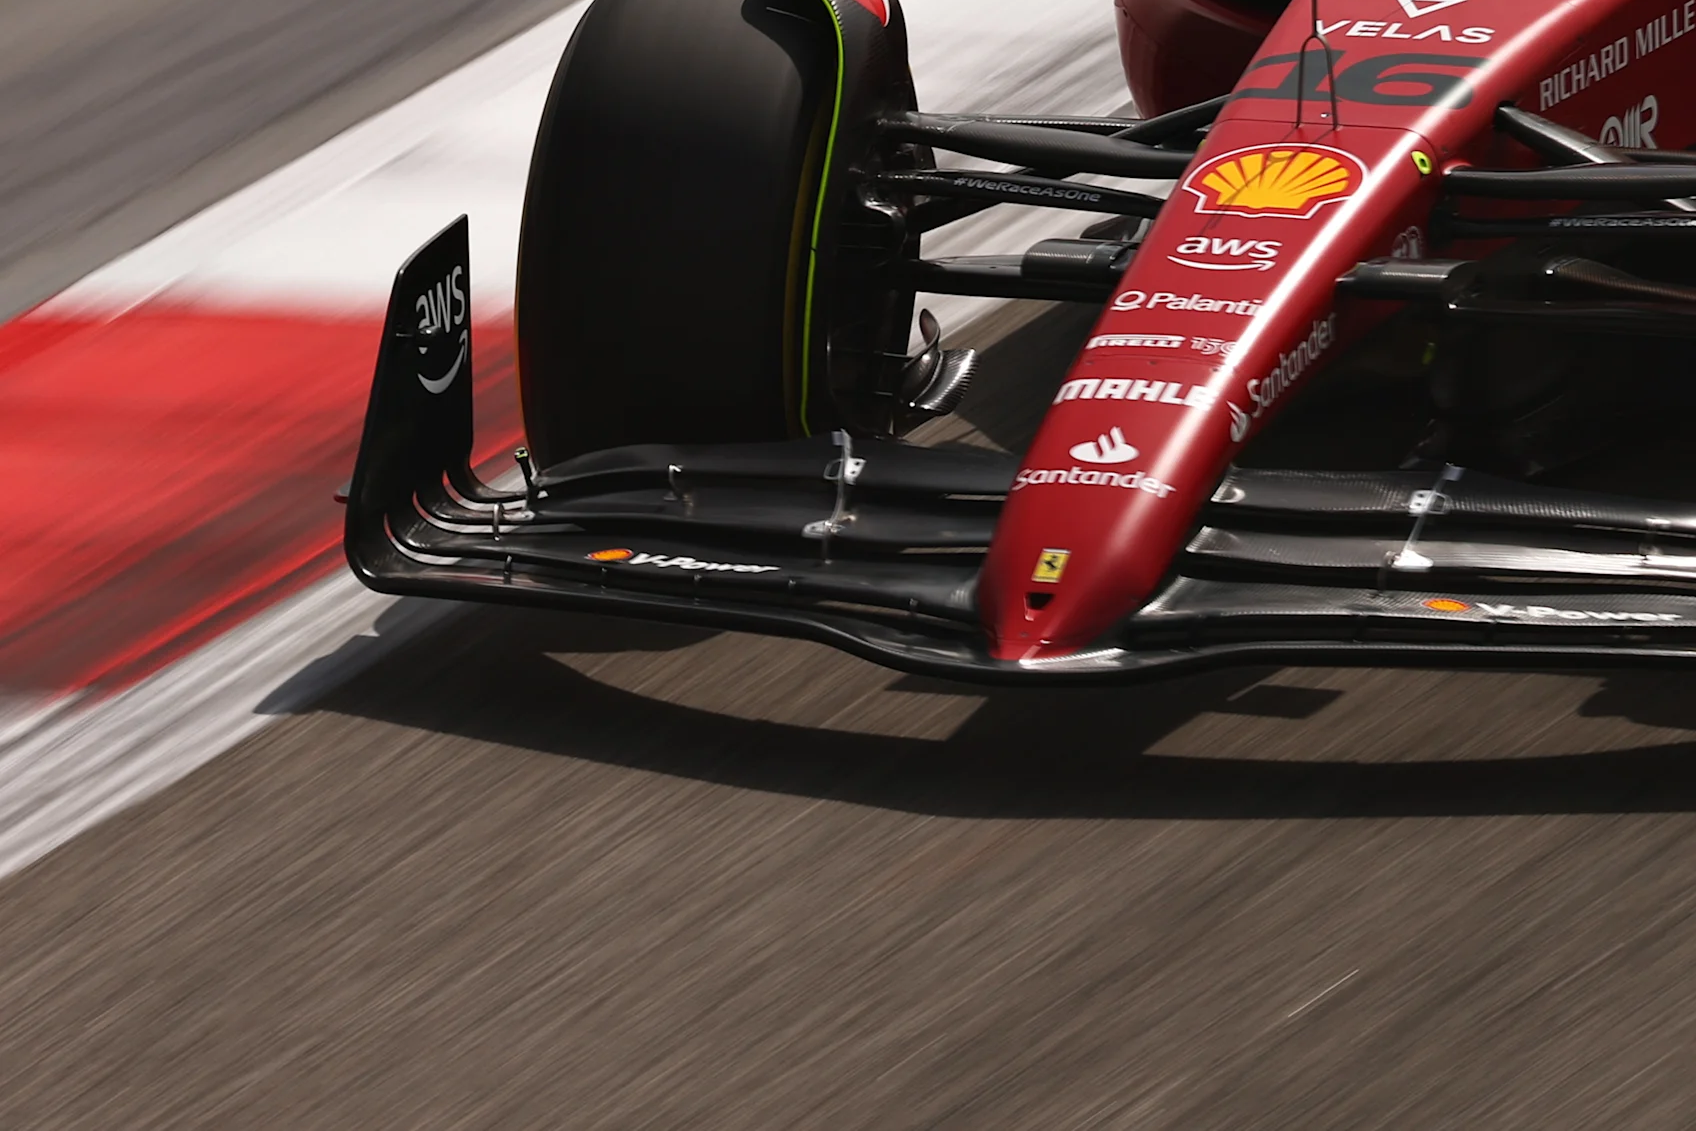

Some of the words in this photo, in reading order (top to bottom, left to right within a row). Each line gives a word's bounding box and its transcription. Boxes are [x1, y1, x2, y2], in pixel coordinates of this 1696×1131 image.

[1315, 19, 1495, 43] VELAS
[1540, 36, 1629, 112] RICHARD
[1635, 0, 1696, 60] MILLE
[1233, 50, 1487, 110] 16
[954, 177, 1101, 202] #WeRaceAsOne
[1176, 236, 1283, 260] aws
[416, 265, 466, 335] aws
[1146, 292, 1264, 318] Palanti
[1085, 334, 1186, 350] PIRELLI
[1247, 314, 1337, 417] Santander
[1052, 378, 1217, 411] MAHLE
[1012, 467, 1177, 498] Santander
[633, 552, 780, 573] V-Power
[1476, 602, 1682, 623] V-Power
